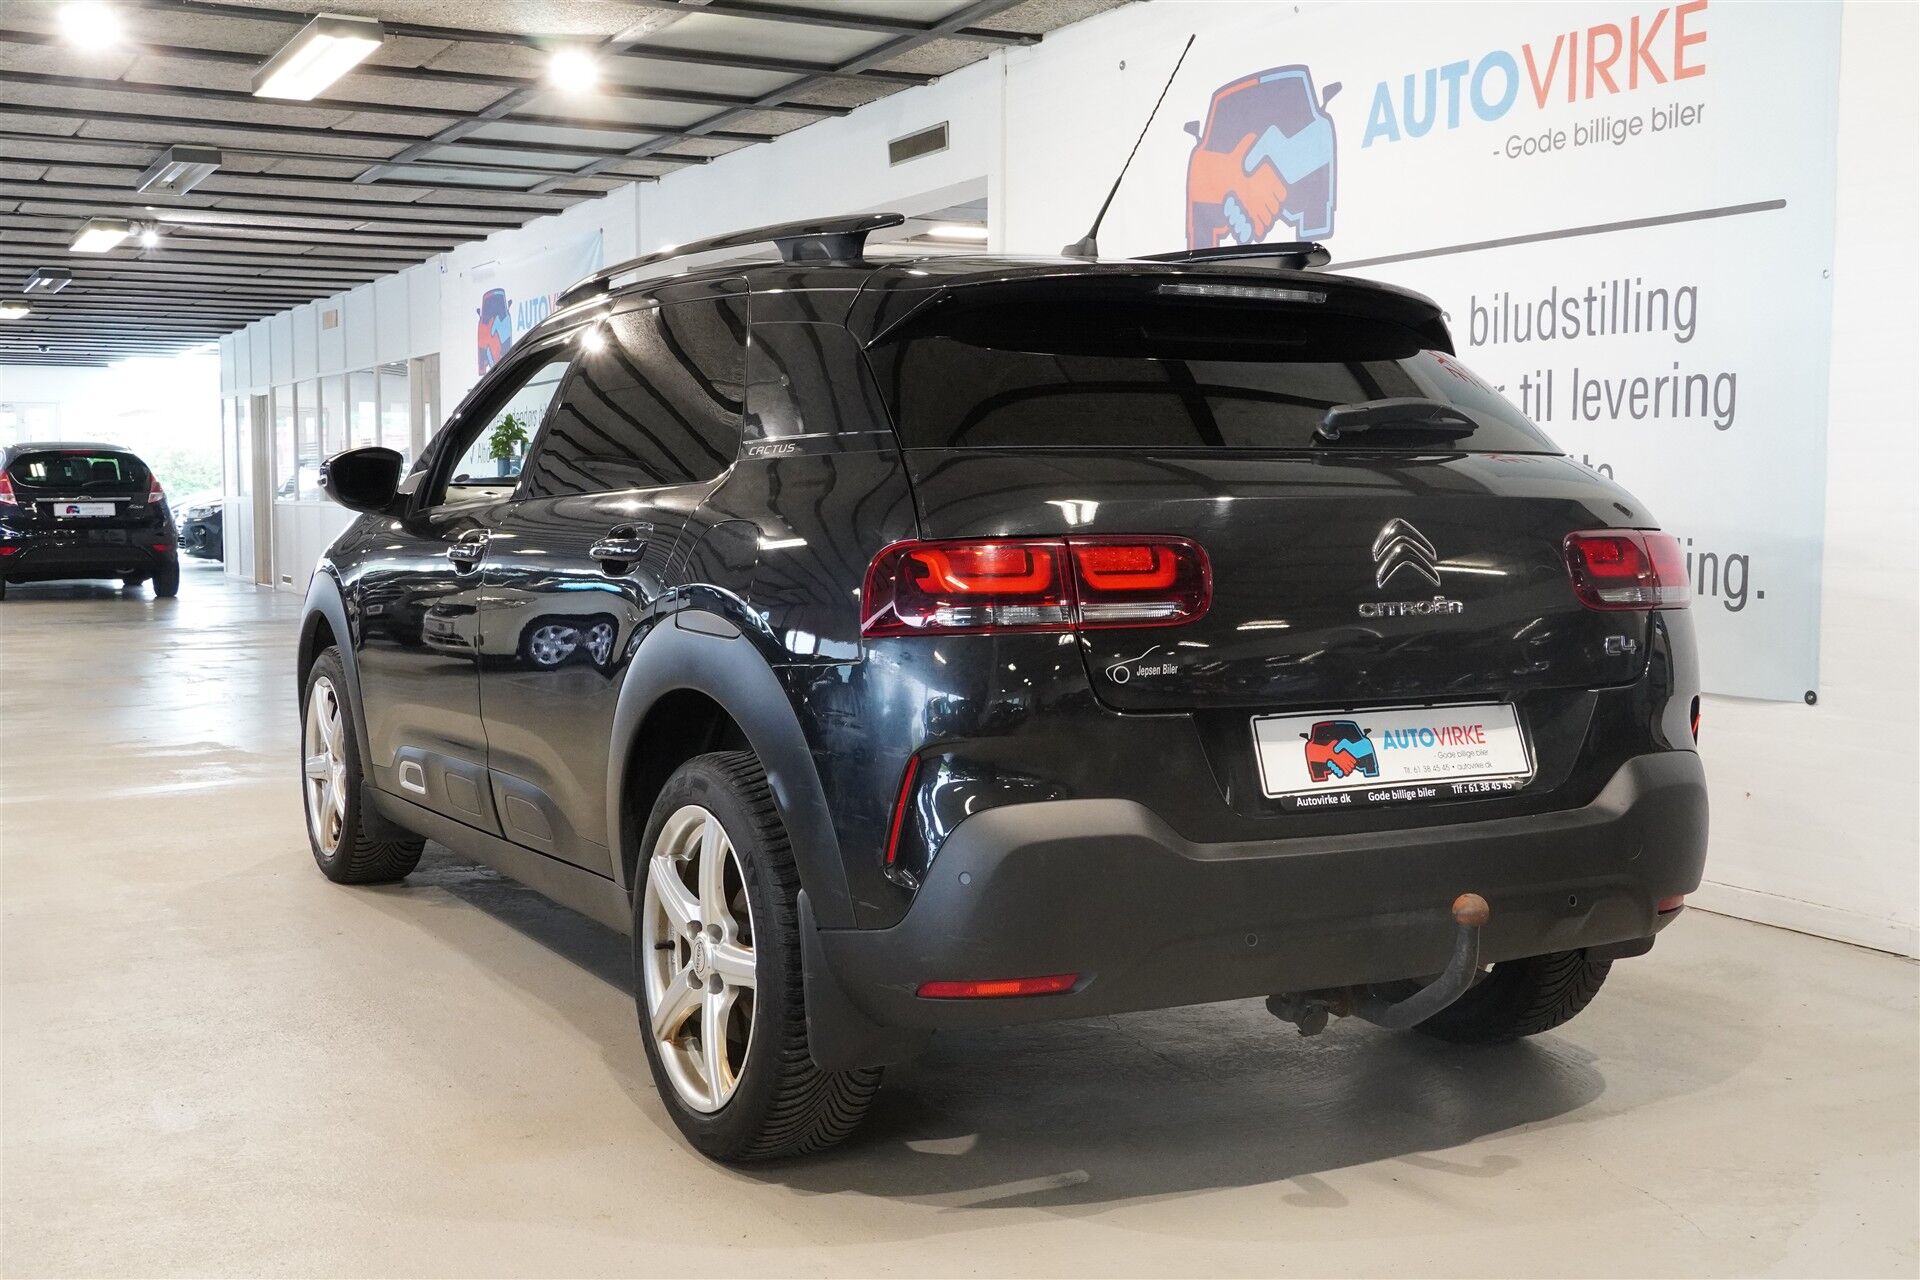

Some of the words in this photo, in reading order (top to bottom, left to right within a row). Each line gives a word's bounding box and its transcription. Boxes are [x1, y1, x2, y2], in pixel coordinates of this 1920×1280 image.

[1361, 0, 1708, 149] AUTOVIRKE
[1505, 127, 1567, 160] Gode
[1573, 115, 1644, 146] billige
[1651, 102, 1706, 133] biler
[1469, 277, 1699, 347] biludstilling
[1519, 369, 1553, 422] til
[1571, 361, 1738, 431] levering
[748, 443, 796, 456] CACTUS
[1604, 635, 1638, 656] C4
[1136, 665, 1161, 678] Jepsen
[1162, 663, 1179, 675] Biler
[1383, 724, 1487, 750] AUTOVIRKE
[1296, 795, 1338, 807] Autovirke
[1368, 790, 1390, 801] Gode
[1391, 789, 1416, 800] billige
[1418, 787, 1436, 798] biler
[1468, 783, 1479, 793] 61
[1480, 782, 1490, 792] 38
[1491, 782, 1501, 791] 45
[1502, 781, 1513, 790] 45
